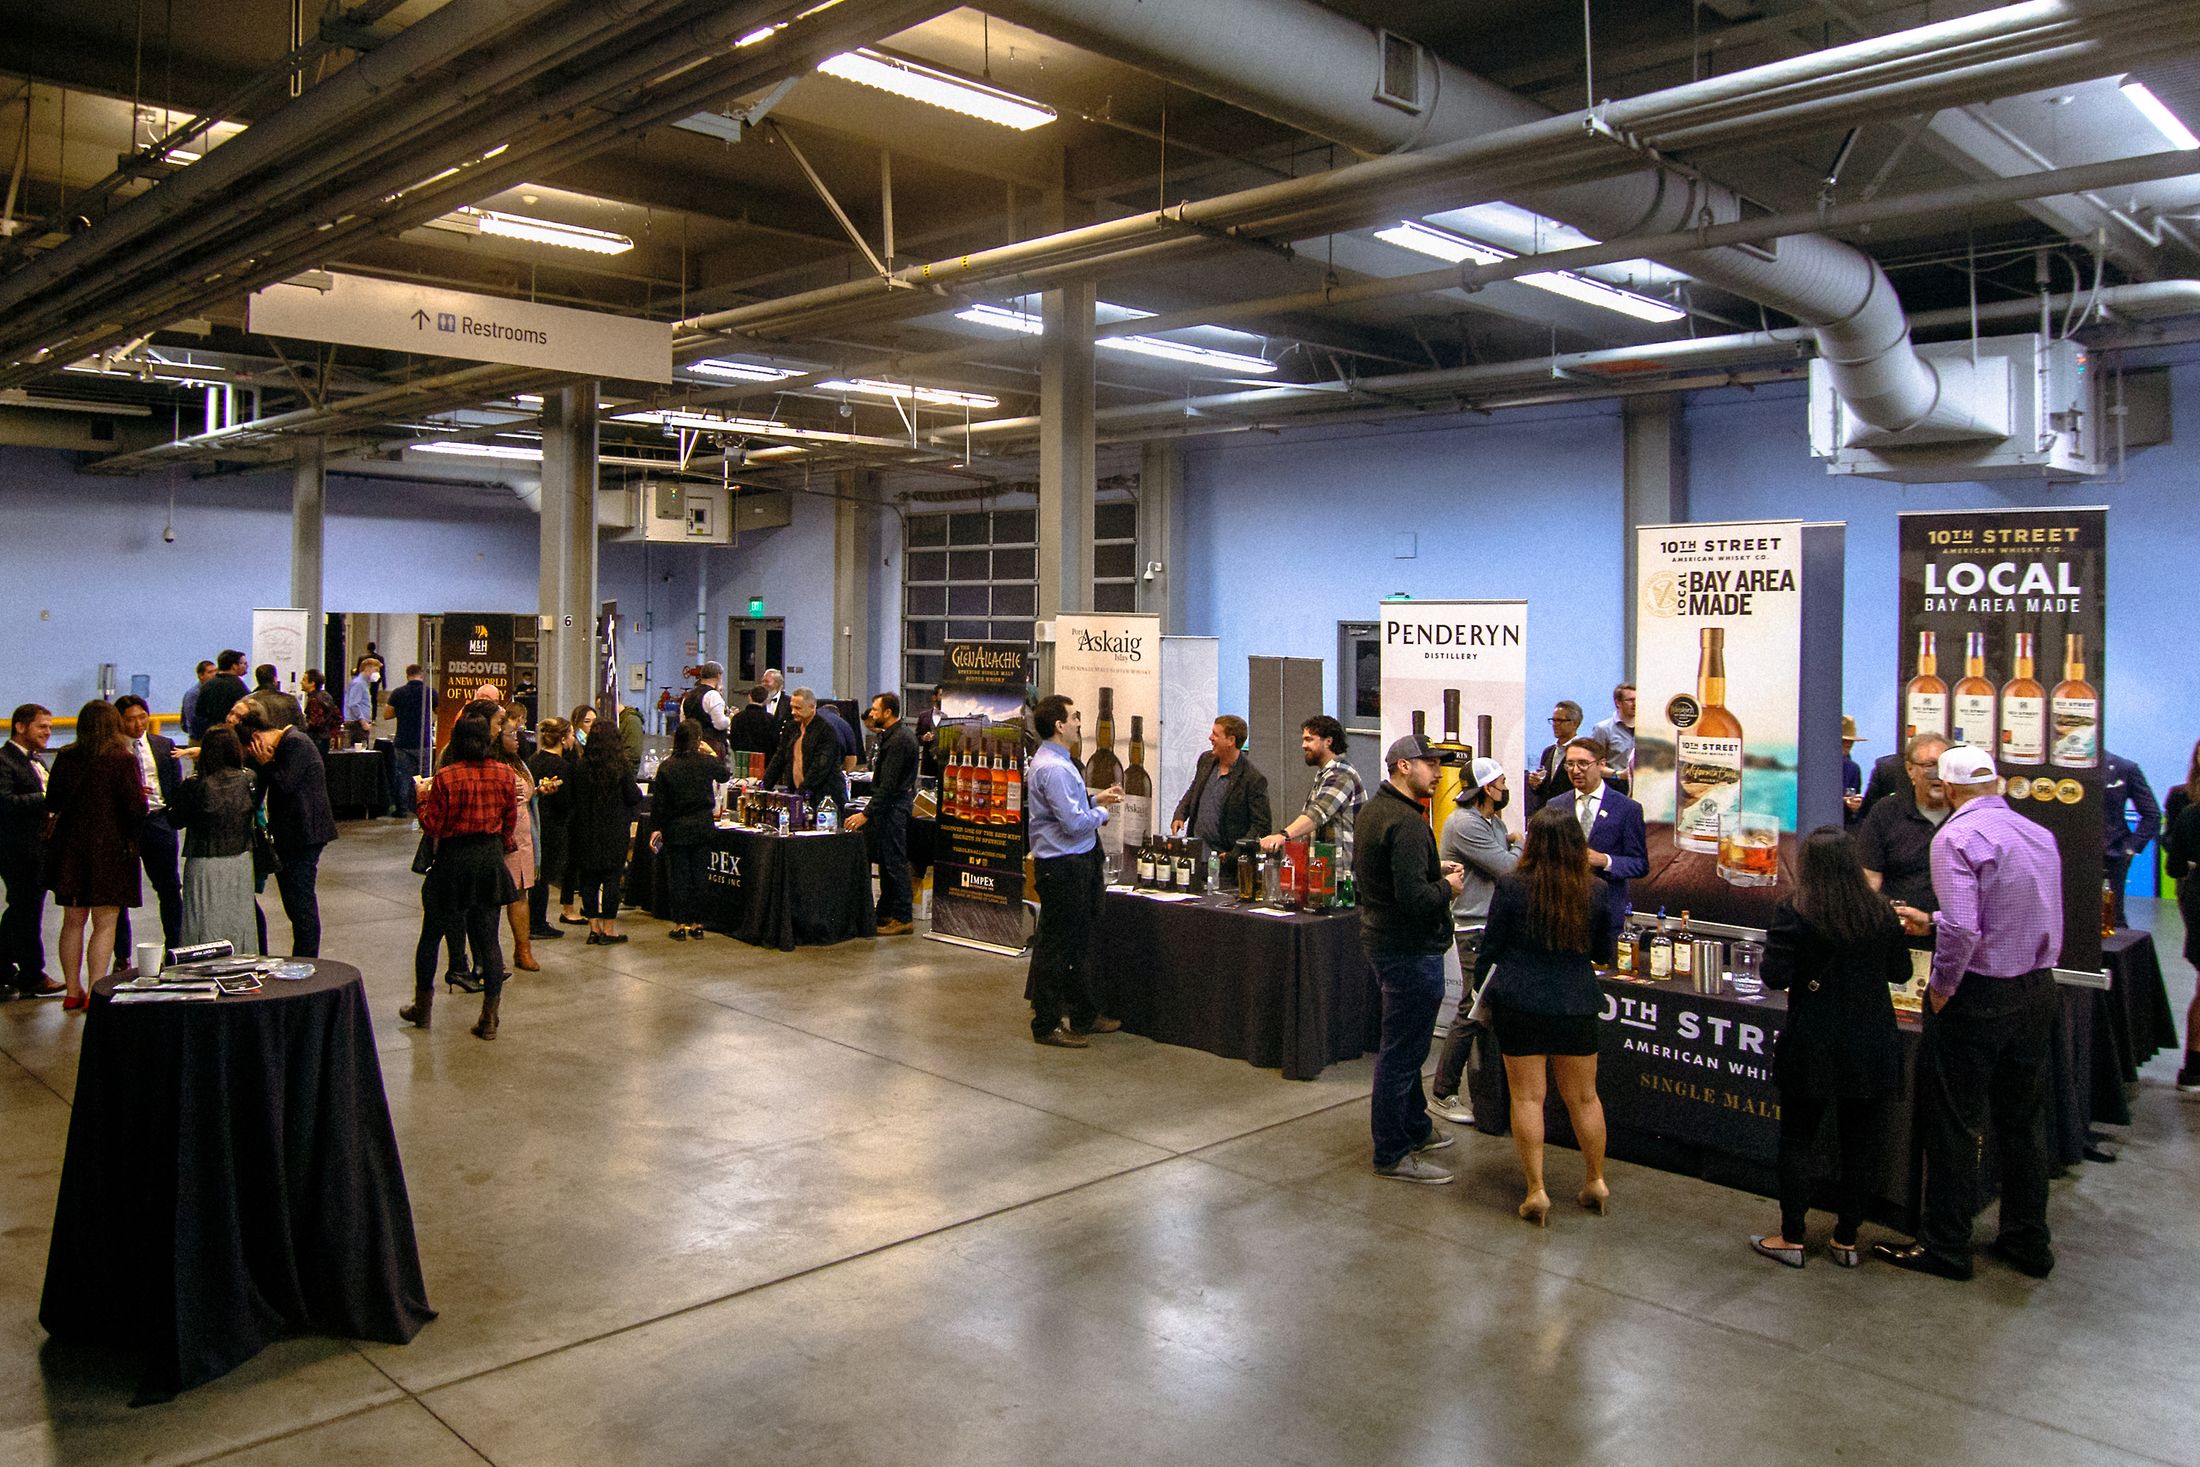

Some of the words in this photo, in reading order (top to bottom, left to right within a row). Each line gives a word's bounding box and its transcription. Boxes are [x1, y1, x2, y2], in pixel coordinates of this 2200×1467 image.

[462, 316, 547, 344] Restrooms
[1928, 530, 1973, 544] 10TH
[1982, 528, 2080, 544] STREET
[1660, 540, 1696, 553] 10TH
[1704, 538, 1782, 552] STREET
[1690, 571, 1732, 592] BAY
[1735, 570, 1795, 592] AREA
[1925, 562, 2081, 596] LOCAL
[1678, 572, 1687, 616] LOCAL
[1689, 594, 1752, 616] MADE
[1925, 598, 1958, 612] BAY
[1968, 598, 2016, 612] AREA
[2026, 598, 2080, 612] MADE
[564, 616, 572, 627] 6
[1388, 621, 1519, 646] PENDERYN
[470, 640, 488, 652] M&H
[1078, 629, 1142, 662] Askaig
[1424, 652, 1478, 660] DISTILLERY
[448, 661, 507, 674] DISCOVER
[448, 676, 454, 685] A
[456, 676, 473, 686] NEW
[475, 678, 507, 687] WORLD
[447, 688, 462, 699] OF
[1702, 744, 1738, 752] STREET
[2037, 785, 2050, 794] 96
[2062, 786, 2076, 794] 94
[708, 851, 741, 876] PEX
[1598, 993, 1657, 1031] 0TH
[1677, 1011, 1779, 1056] STR
[1624, 1038, 1719, 1070] AMERICAN
[1728, 1061, 1773, 1081] WHI
[1640, 1072, 1716, 1104] SINGLE
[1723, 1092, 1782, 1120] MALT
